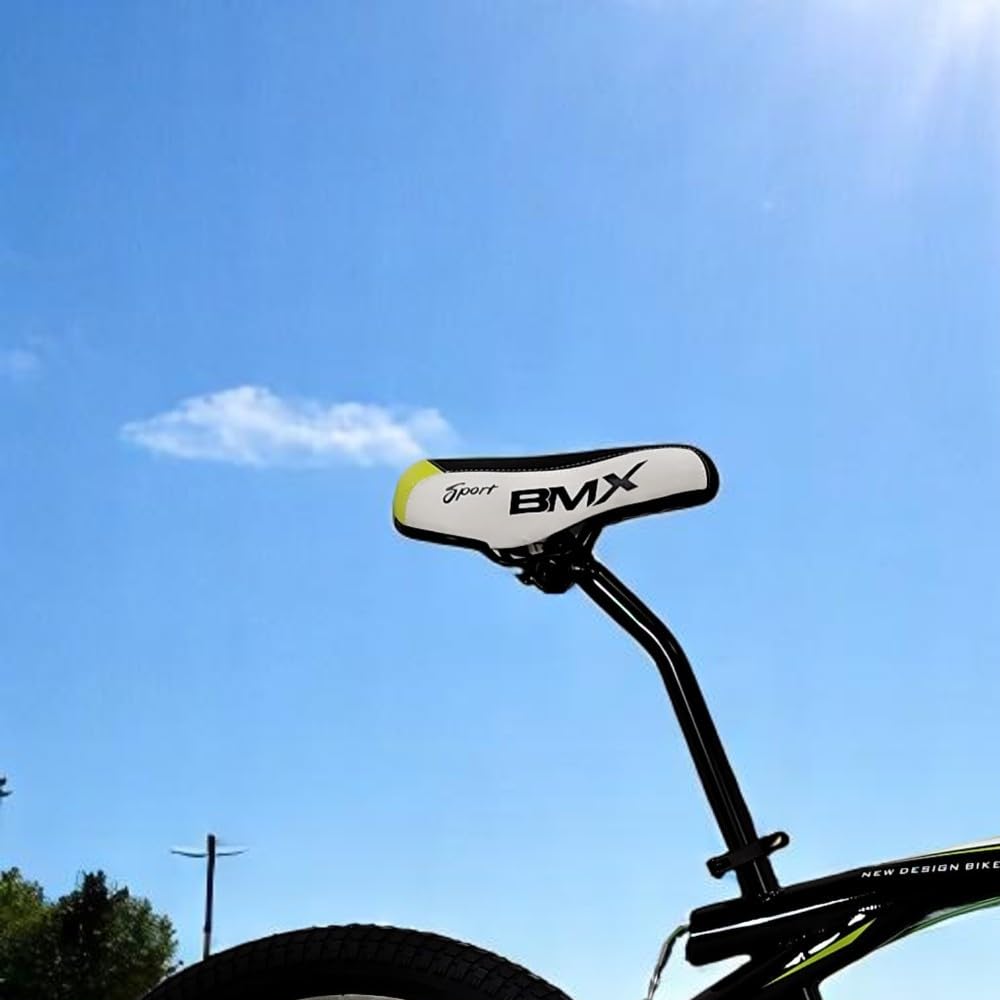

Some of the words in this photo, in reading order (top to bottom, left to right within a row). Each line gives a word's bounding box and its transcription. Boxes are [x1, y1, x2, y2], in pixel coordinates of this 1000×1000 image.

[442, 482, 498, 504] Sport
[509, 460, 648, 515] BMX
[861, 869, 895, 879] NEW
[899, 864, 960, 875] DESIGN
